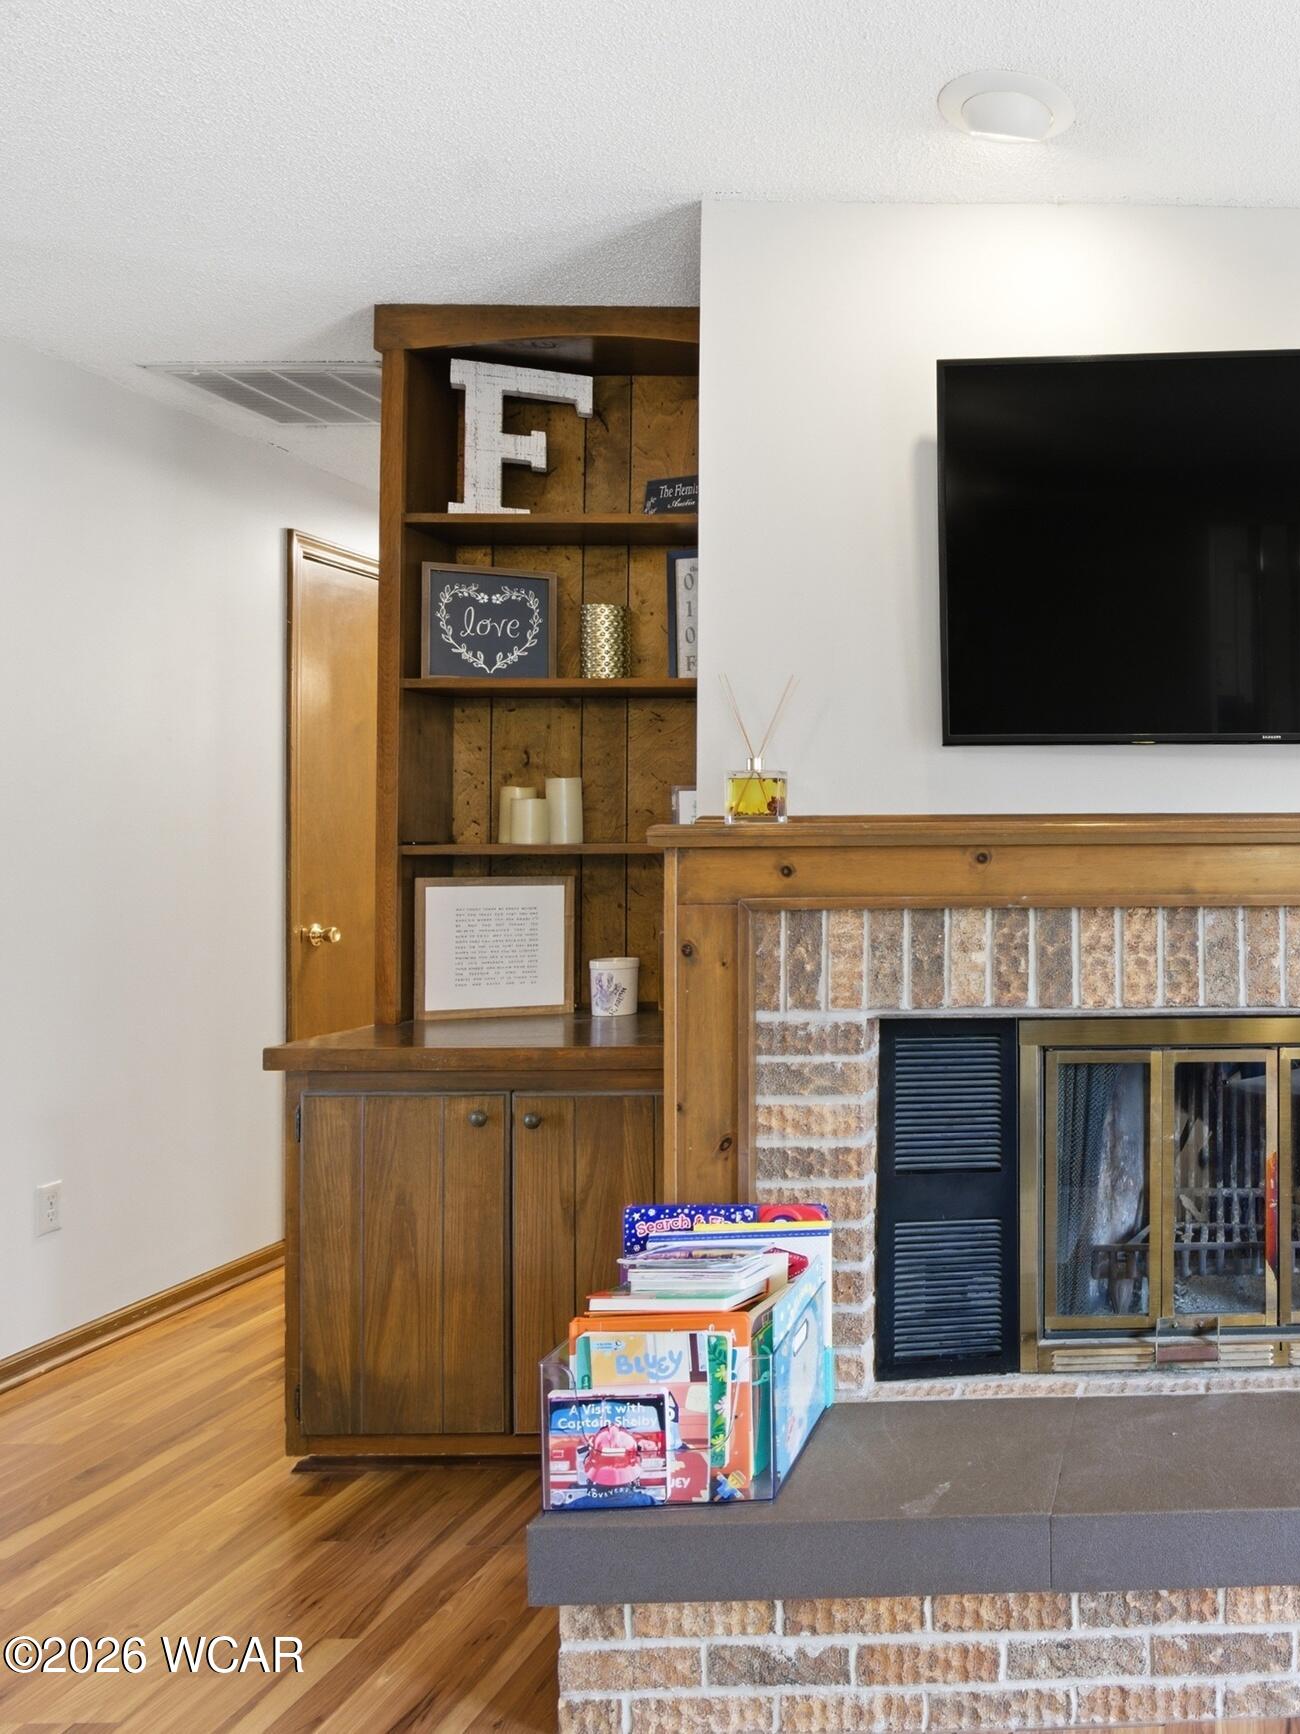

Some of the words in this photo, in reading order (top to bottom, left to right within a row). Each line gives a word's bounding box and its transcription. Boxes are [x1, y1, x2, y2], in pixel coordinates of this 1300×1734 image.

[448, 358, 594, 514] F
[659, 484, 673, 498] The
[459, 606, 520, 638] love
[635, 1213, 690, 1237] Search
[615, 1349, 683, 1381] BLUEY
[569, 1404, 579, 1416] A
[582, 1403, 612, 1415] Visit
[616, 1402, 645, 1413] with
[558, 1415, 612, 1431] Captain
[616, 1416, 657, 1429] Shelby
